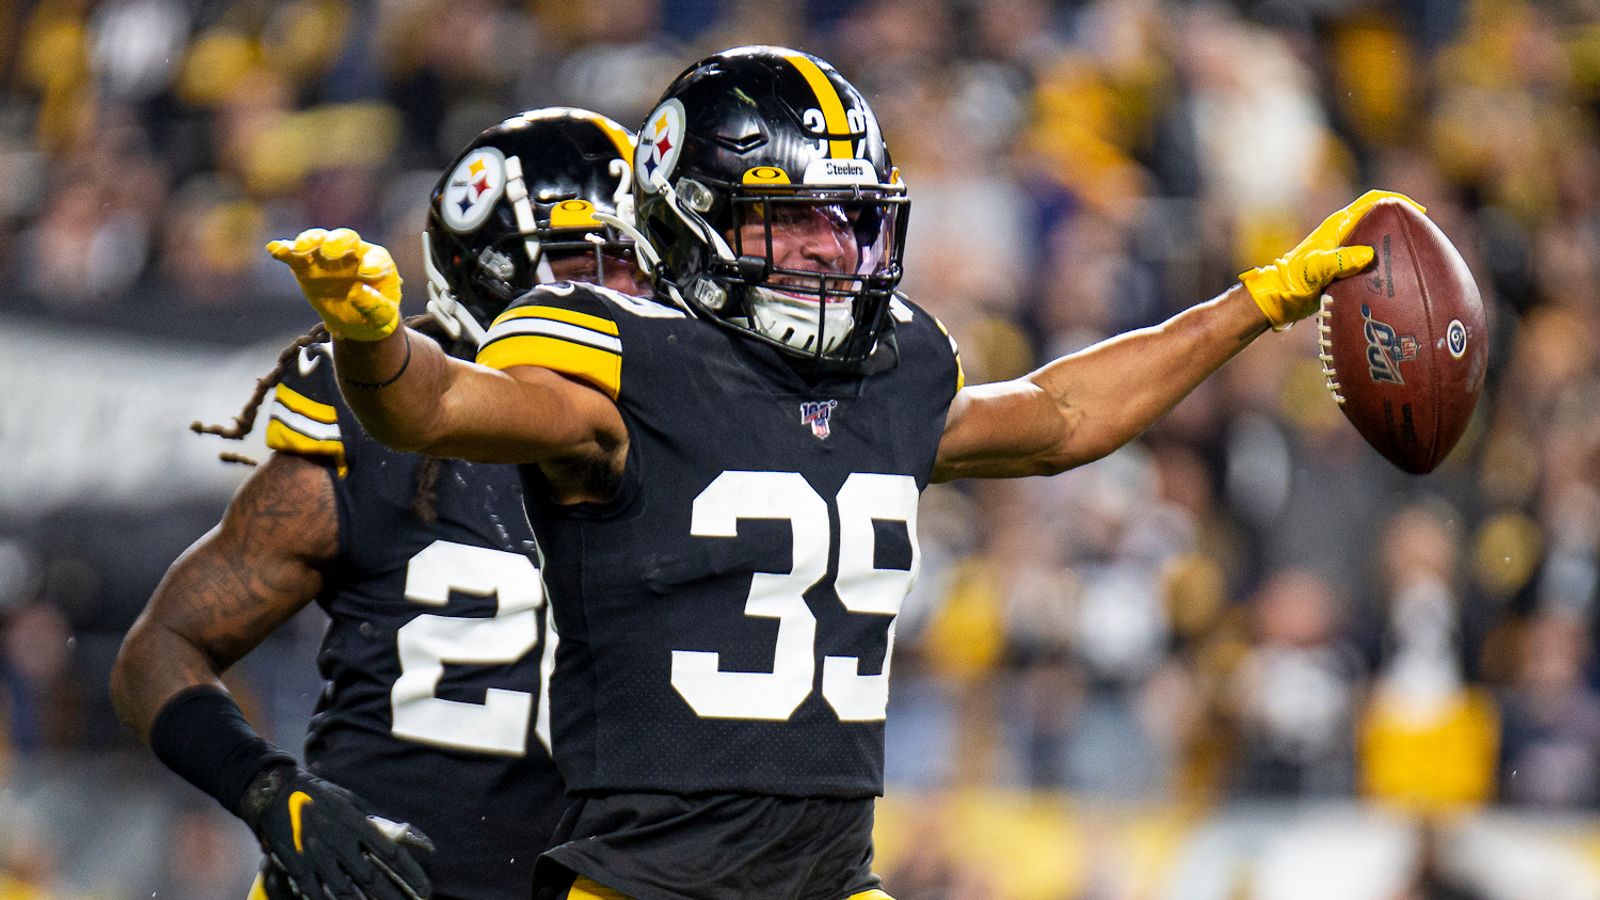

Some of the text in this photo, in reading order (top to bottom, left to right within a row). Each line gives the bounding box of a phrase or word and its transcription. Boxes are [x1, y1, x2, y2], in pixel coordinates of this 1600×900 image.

[826, 162, 864, 176] Steelers
[391, 539, 560, 758] 2
[671, 470, 920, 721] 39
